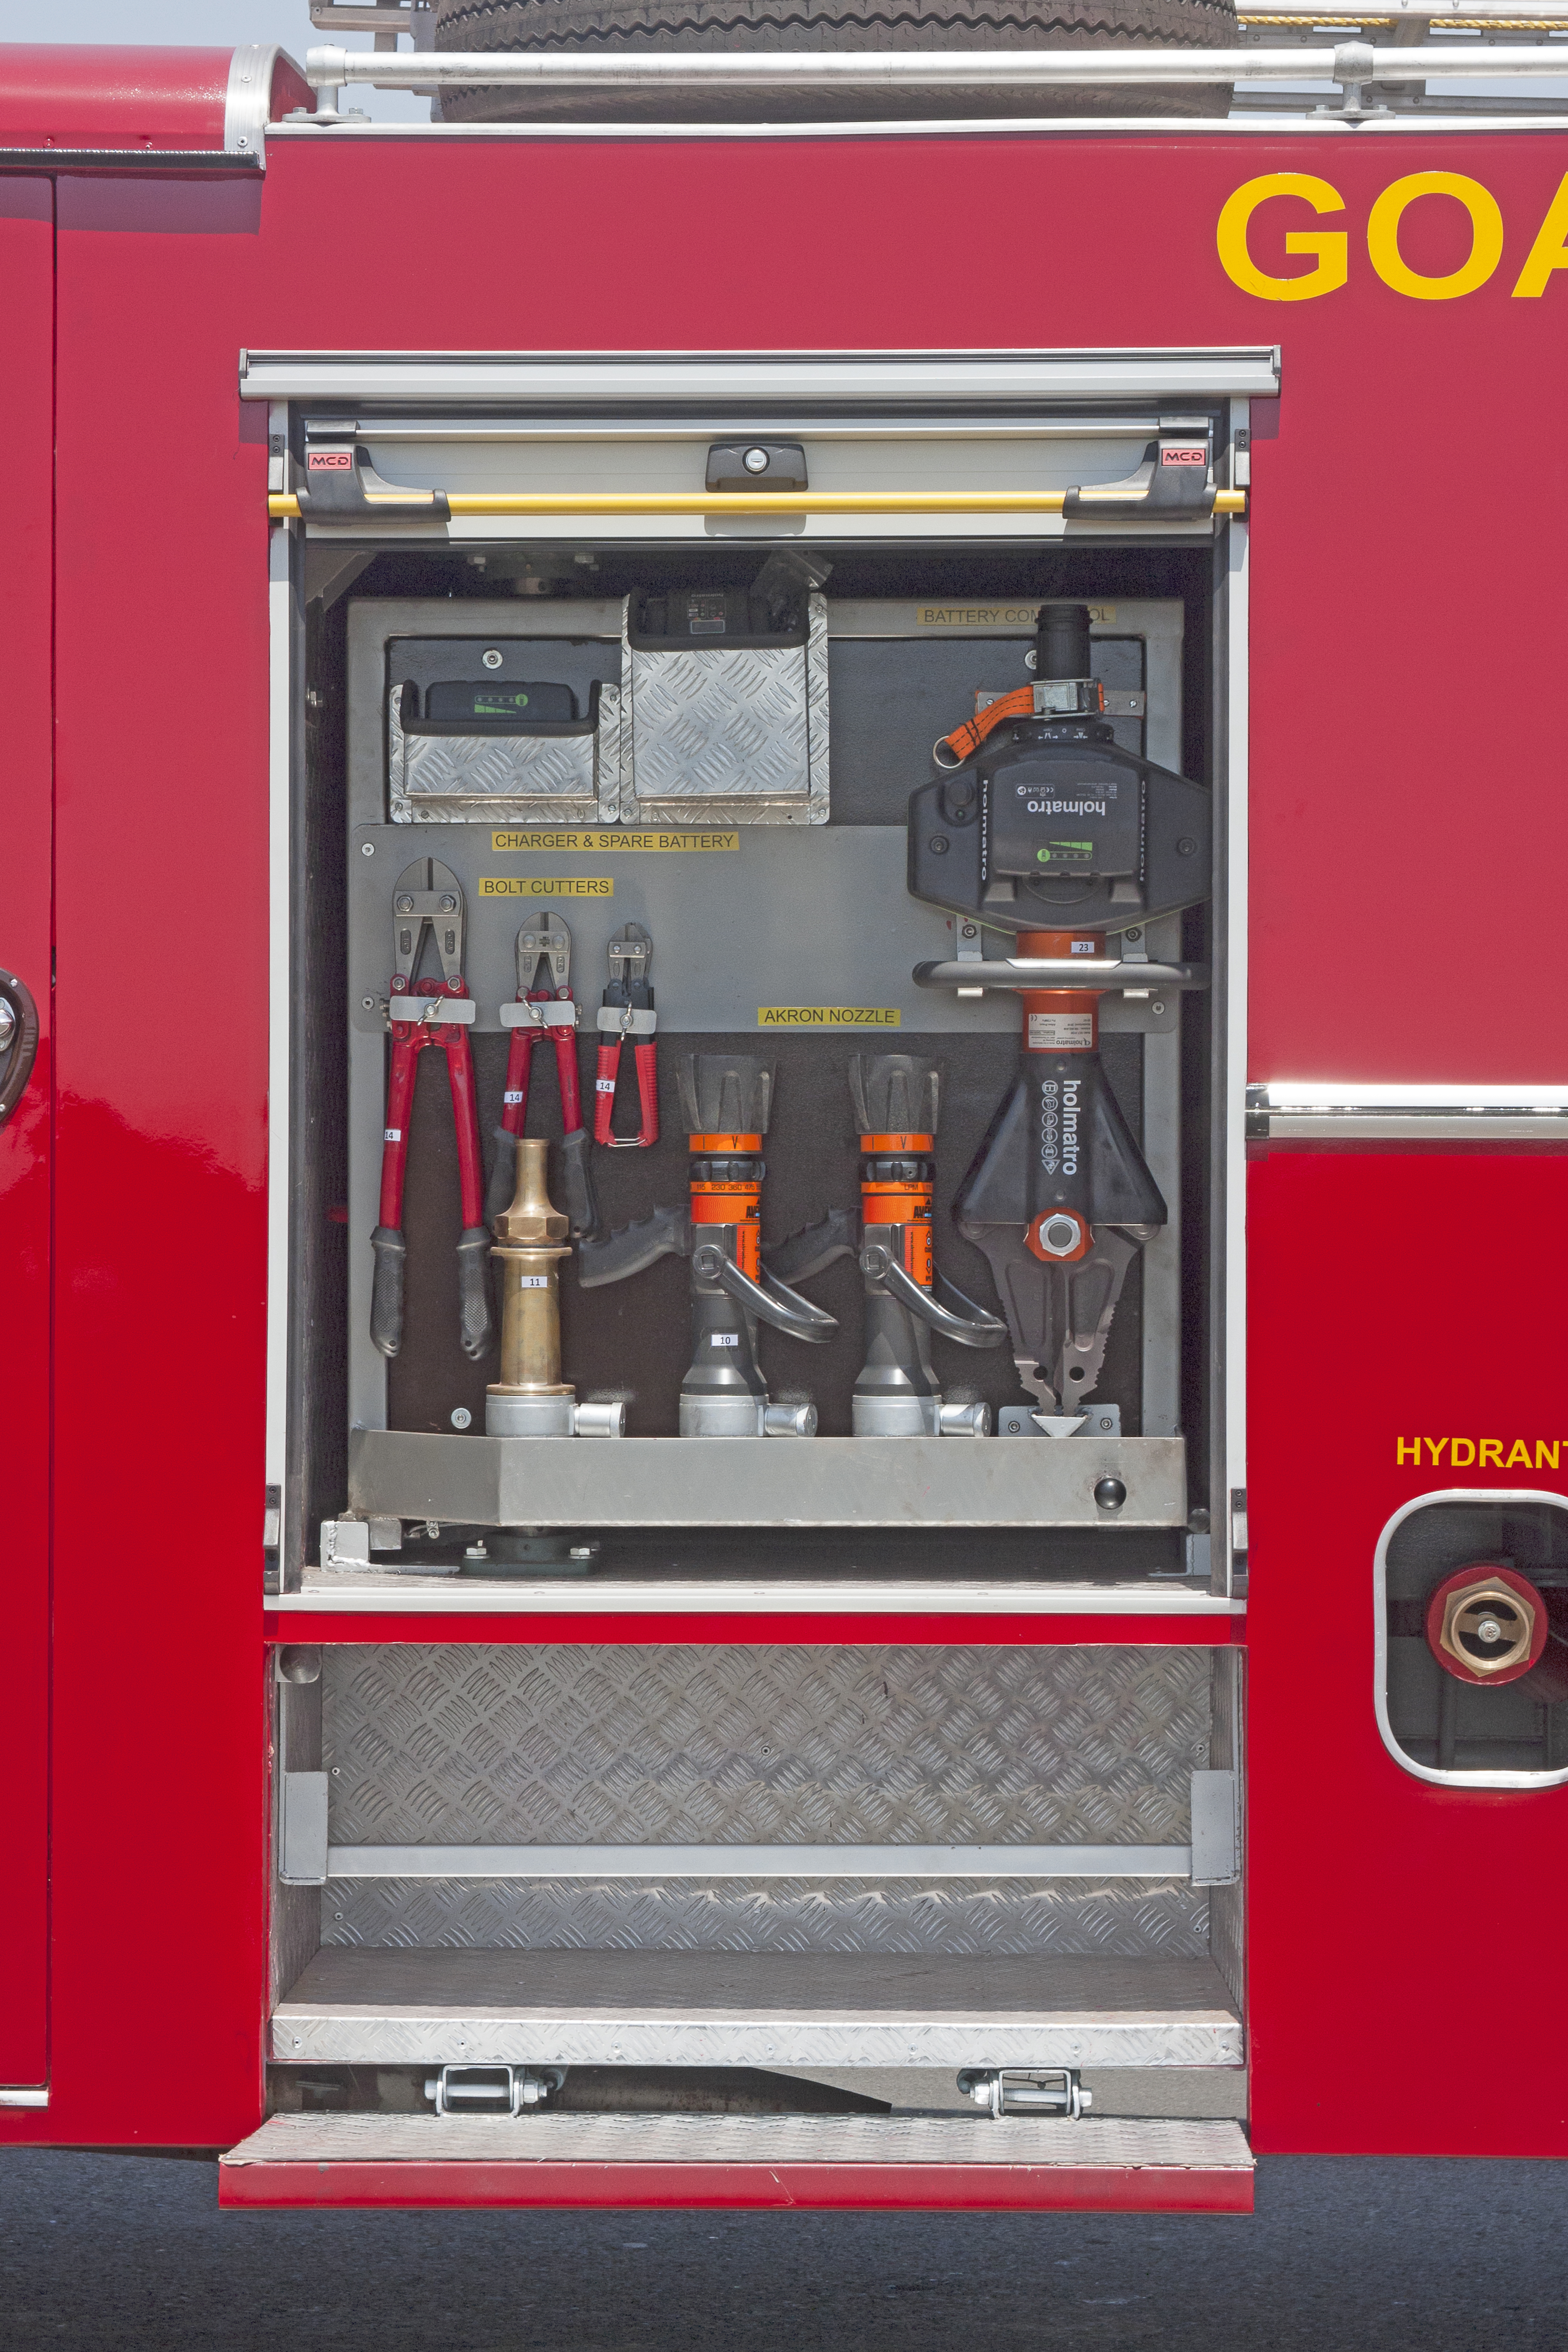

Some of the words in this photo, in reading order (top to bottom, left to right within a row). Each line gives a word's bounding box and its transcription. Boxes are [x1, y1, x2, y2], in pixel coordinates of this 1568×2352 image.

[311, 457, 348, 465] MCD
[1165, 452, 1202, 461] MCD
[924, 609, 999, 622] BATTERY
[1027, 800, 1106, 816] holmatro
[495, 834, 578, 847] CHARGER
[583, 835, 593, 847] &
[599, 835, 653, 848] SPARE
[660, 835, 733, 848] BATTERY
[485, 881, 526, 893] BOLT
[531, 881, 609, 893] CUTTERS
[764, 1009, 823, 1022] AKRON
[830, 1010, 895, 1023] NOZZLE
[599, 1082, 610, 1090] 14
[510, 1093, 520, 1102] 14
[1063, 1080, 1081, 1175] holmatro
[385, 1131, 394, 1139] 14
[1396, 1436, 1568, 1469] HYDRAN
